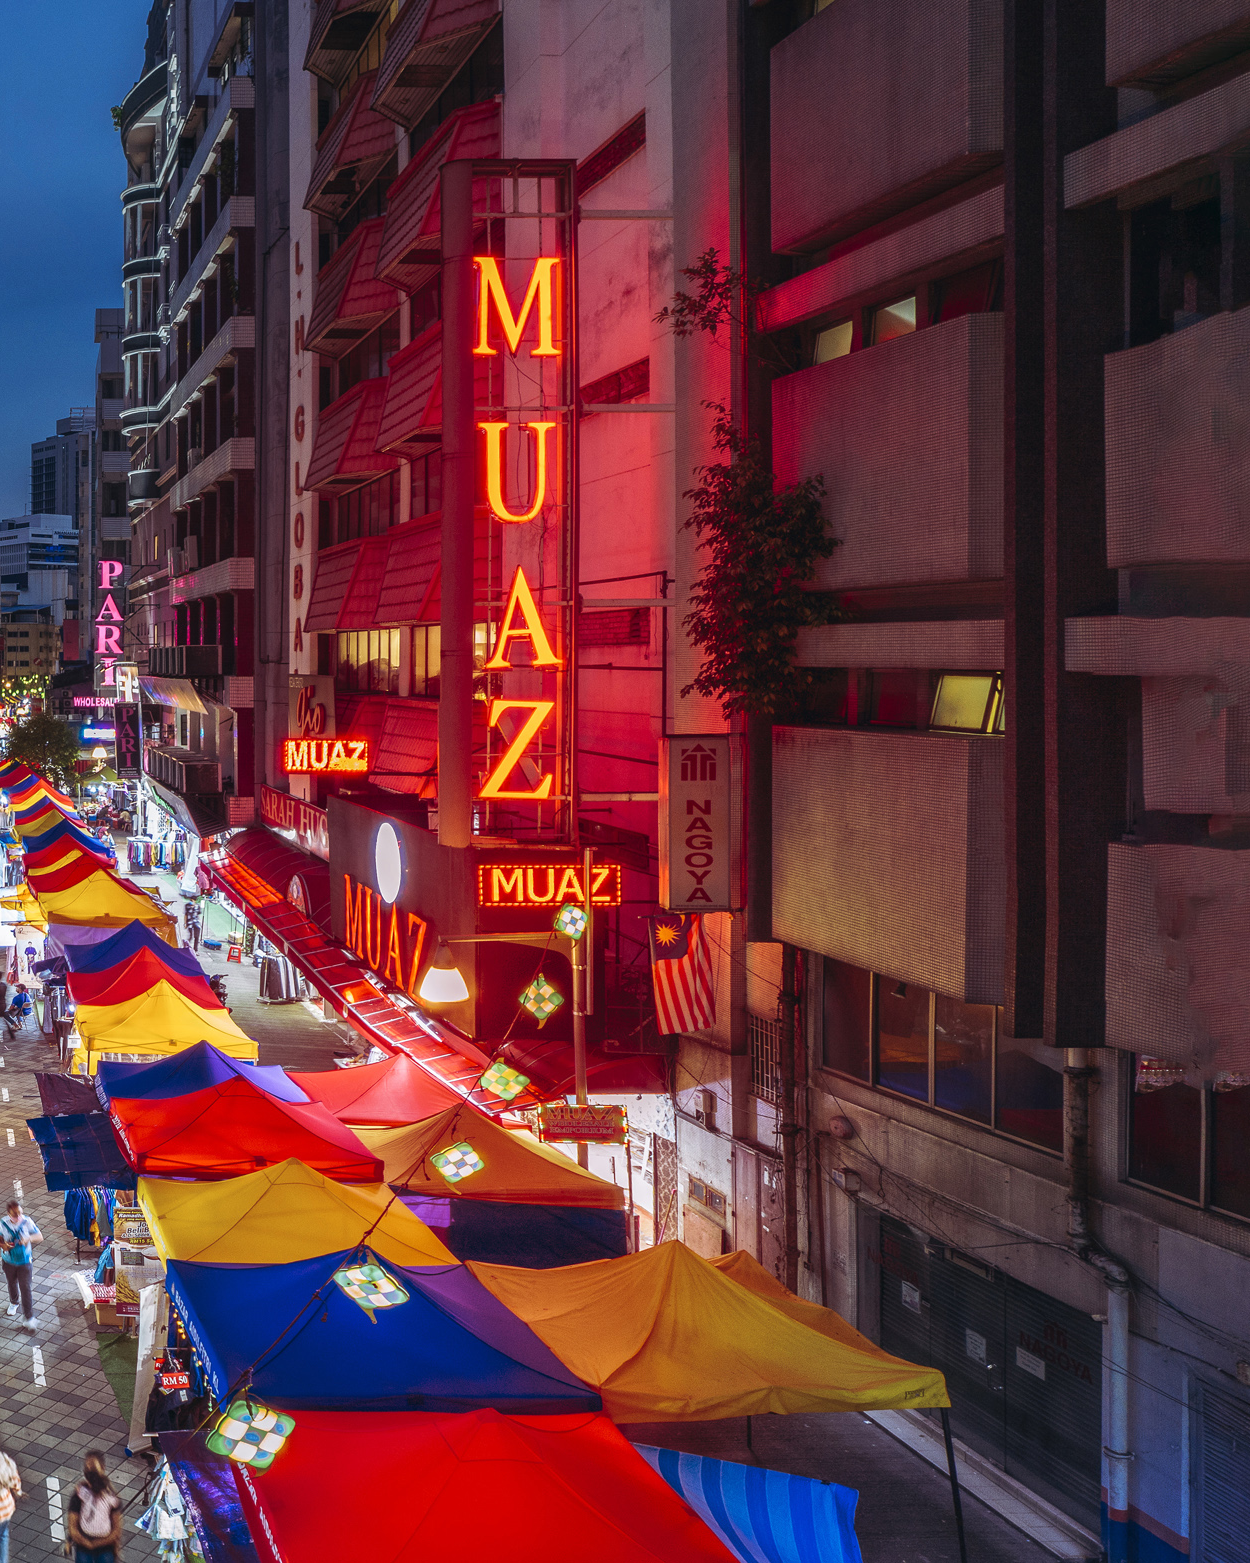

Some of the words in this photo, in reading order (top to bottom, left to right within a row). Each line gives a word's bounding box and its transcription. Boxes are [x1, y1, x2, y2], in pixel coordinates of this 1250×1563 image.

[293, 405, 305, 674] GLOBA
[472, 256, 563, 799] MUAZ
[95, 560, 124, 686] PARI
[120, 708, 137, 767] PARI
[287, 740, 366, 770] MUAZ
[260, 787, 295, 829] SARAH
[684, 800, 714, 903] NAGOYA
[492, 868, 611, 902] MUAZ
[344, 873, 427, 1007] MUAZ
[546, 1106, 614, 1120] MUAZ
[162, 1376, 178, 1386] RM
[178, 1375, 188, 1385] 50
